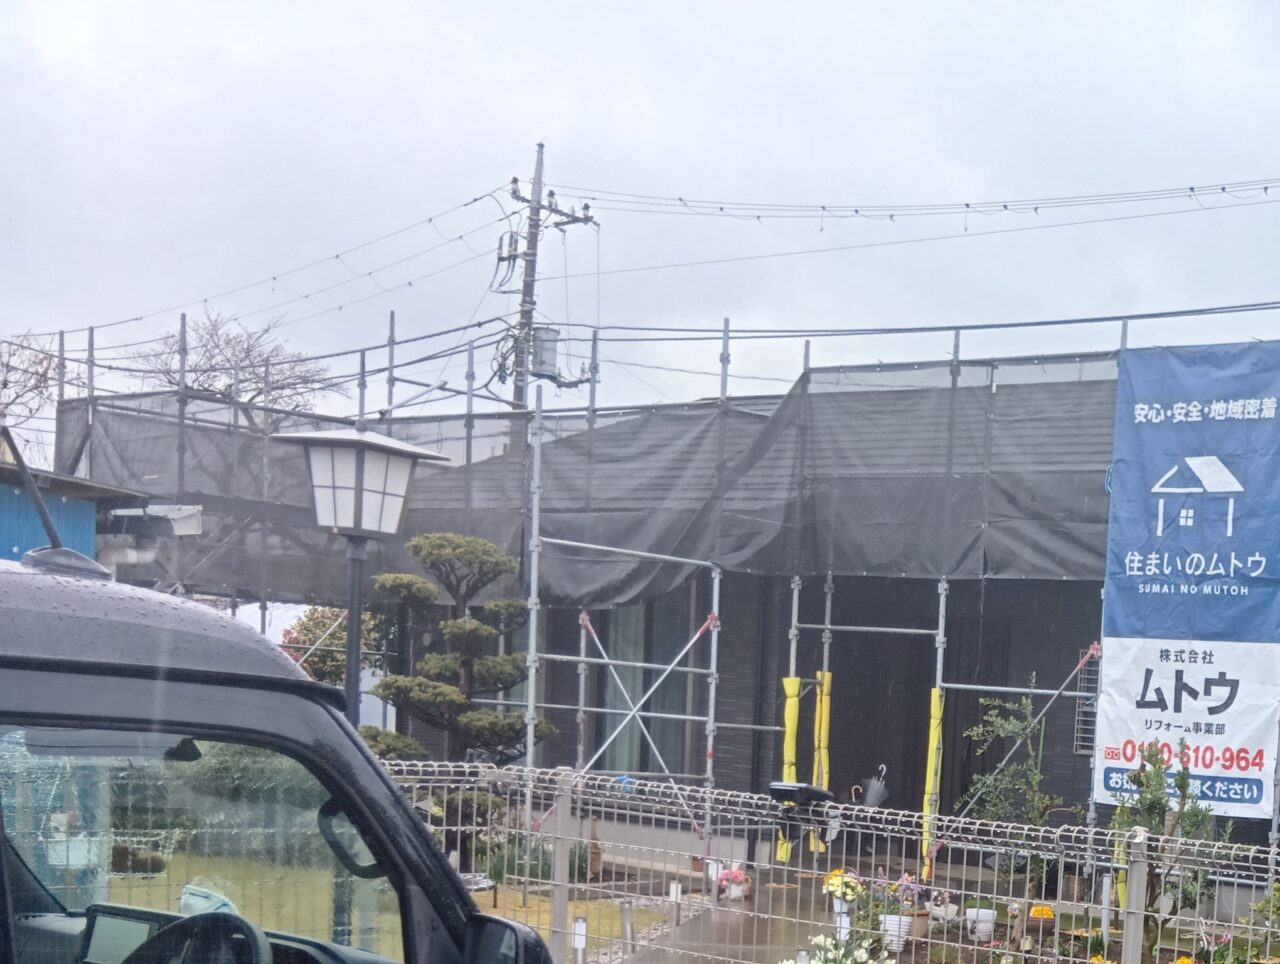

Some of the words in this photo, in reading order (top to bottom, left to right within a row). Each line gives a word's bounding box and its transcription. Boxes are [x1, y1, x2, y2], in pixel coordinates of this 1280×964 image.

[1133, 397, 1278, 424] 安心・安全・地域密着
[1124, 551, 1267, 577] 住まいのムトウ
[1138, 583, 1175, 594] SUMAI
[1180, 584, 1198, 594] NO
[1203, 584, 1249, 596] MUTOH
[1159, 648, 1215, 665] 株式会社
[1135, 667, 1240, 716] ムトウ
[1144, 718, 1226, 736] リフォーム事業部
